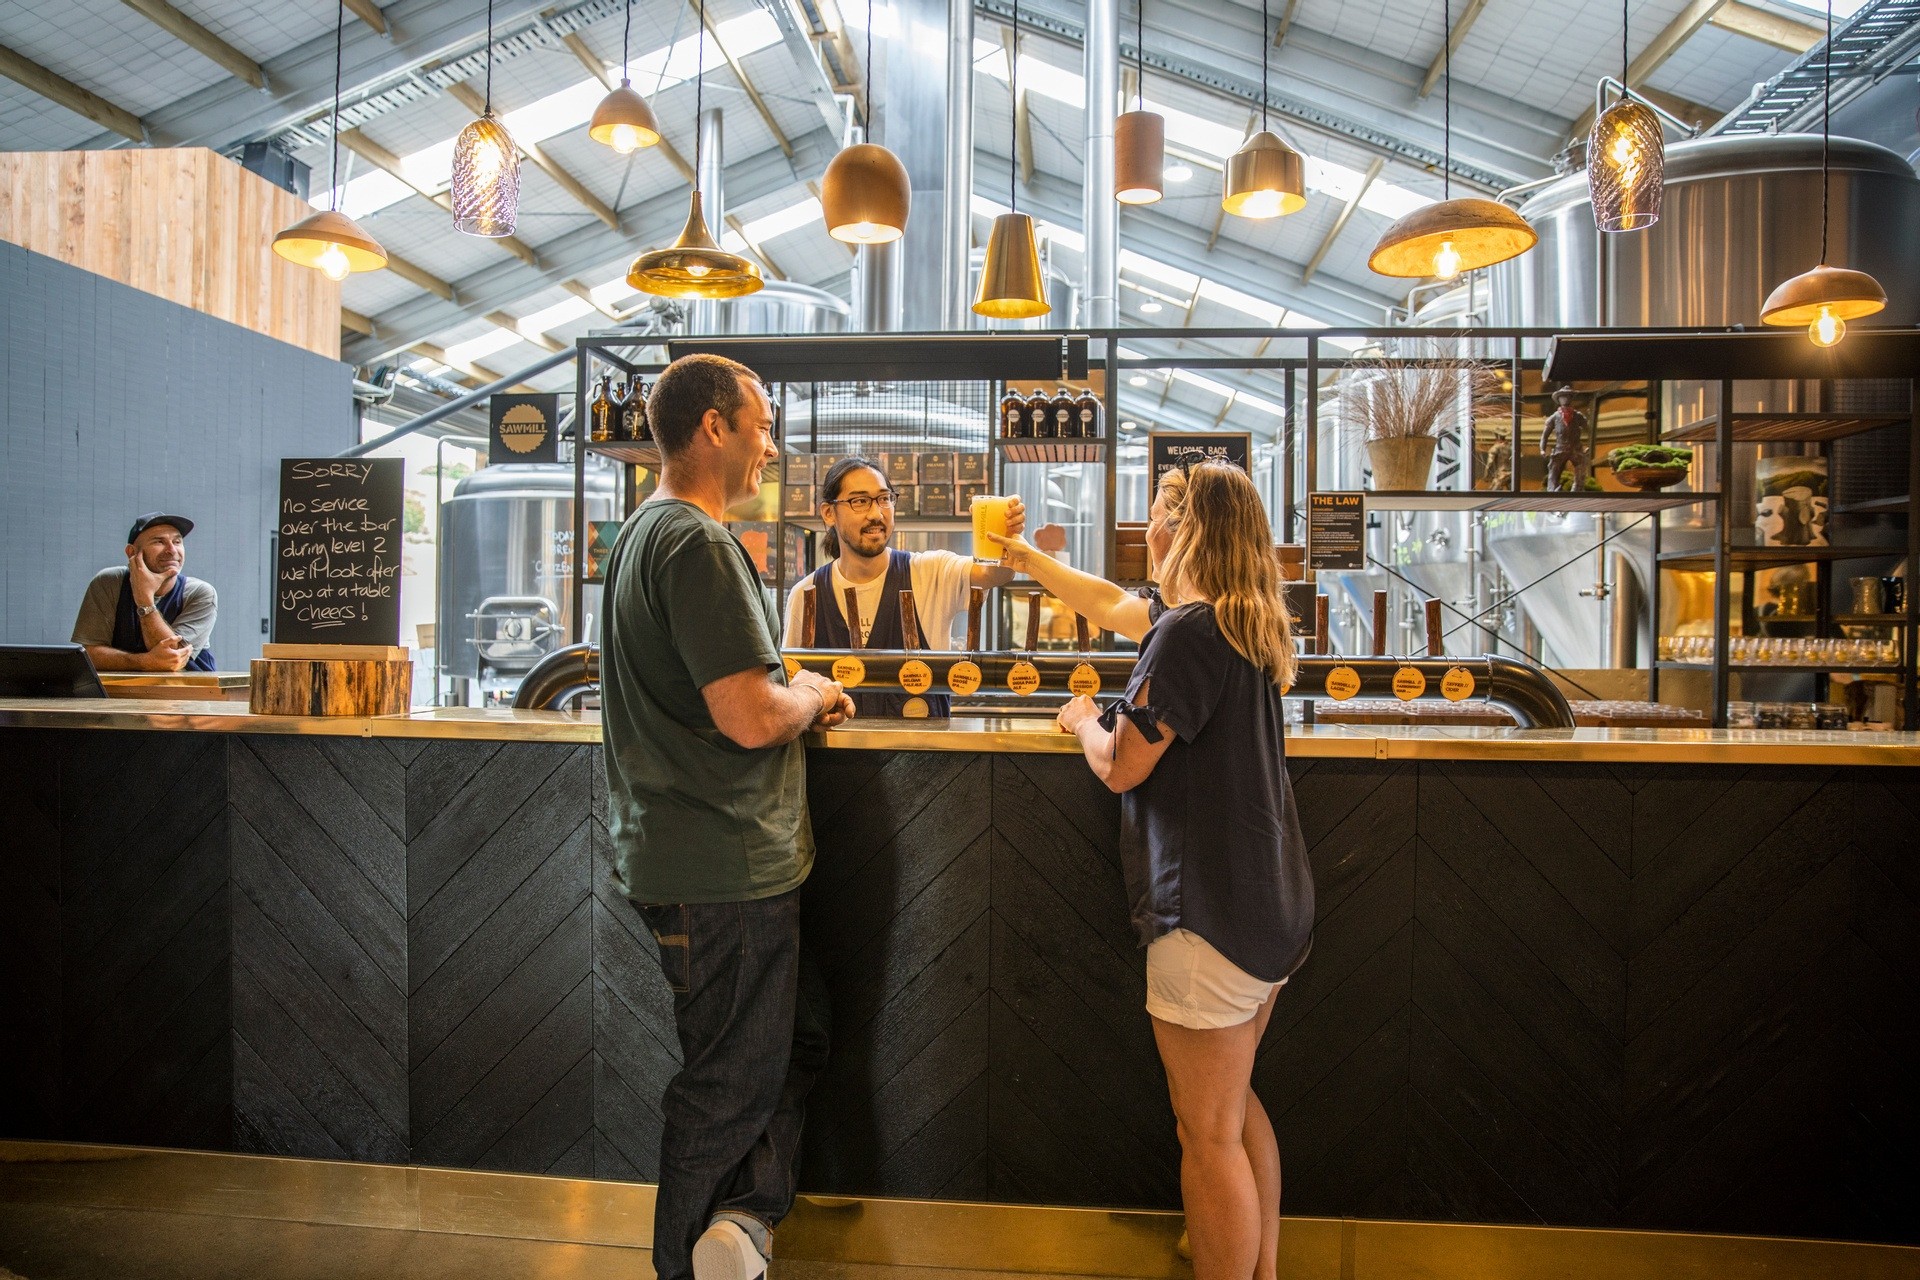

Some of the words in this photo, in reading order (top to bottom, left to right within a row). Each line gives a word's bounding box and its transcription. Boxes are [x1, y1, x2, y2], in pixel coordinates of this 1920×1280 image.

[499, 424, 548, 434] SAWMILL
[1208, 446, 1228, 455] BACK
[292, 462, 374, 485] SORRY
[283, 498, 306, 513] no
[1312, 496, 1333, 505] THE
[1336, 496, 1360, 505] LAW
[281, 520, 319, 536] over
[321, 517, 358, 534] the
[360, 514, 398, 532] bar
[282, 540, 329, 563] during
[331, 537, 365, 554] level
[373, 536, 387, 553] 2
[366, 555, 400, 584] after
[281, 590, 313, 610] you
[316, 584, 334, 598] at
[338, 587, 348, 598] a
[350, 582, 391, 598] table
